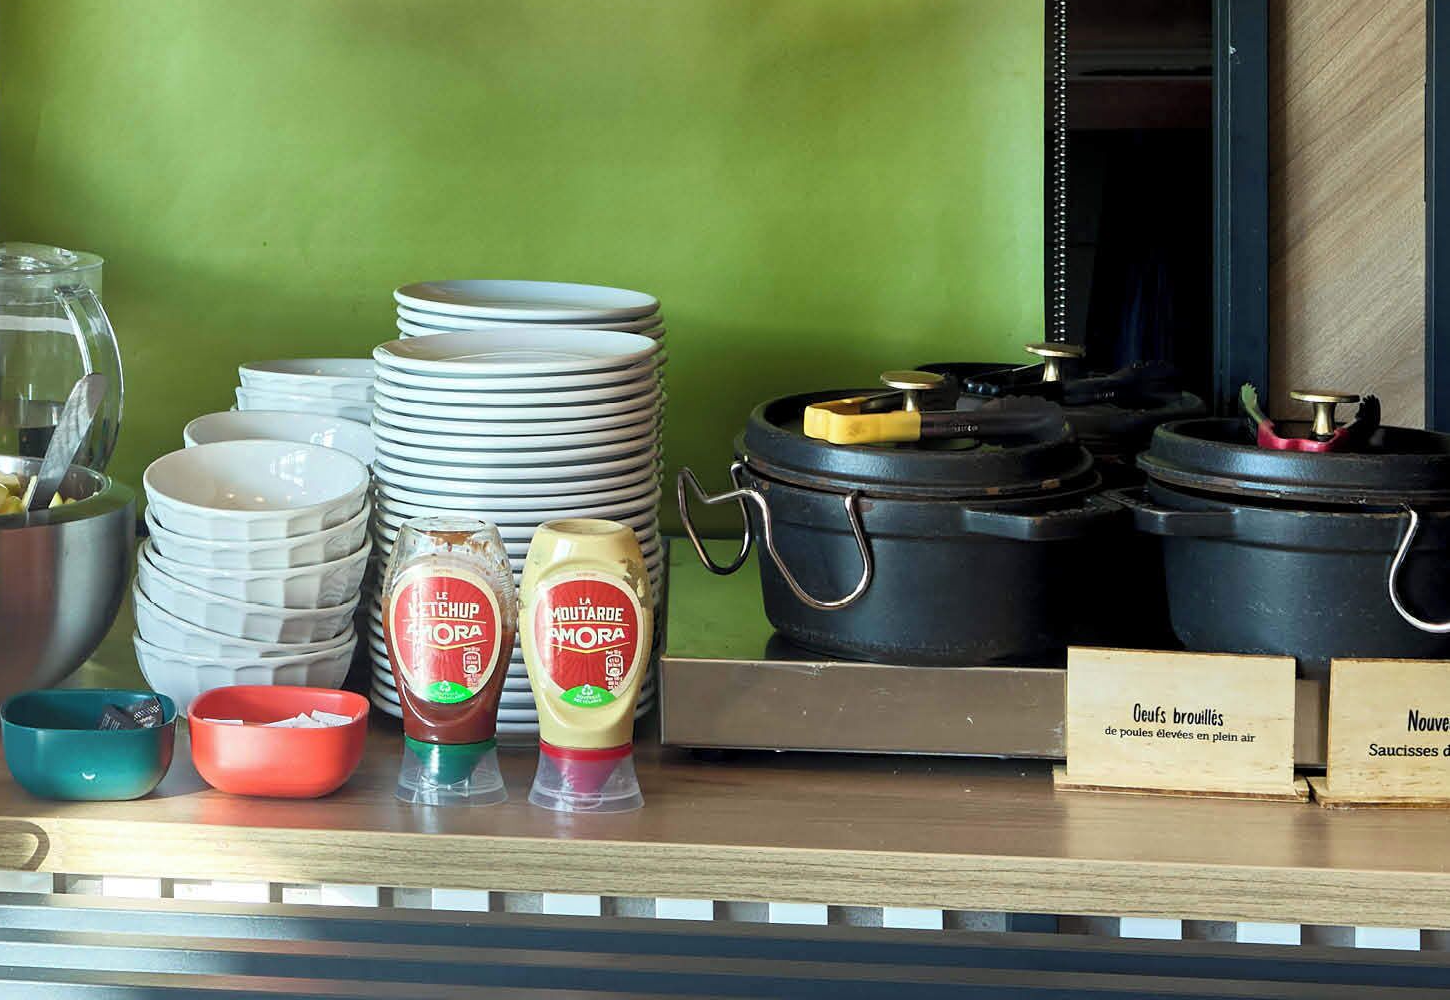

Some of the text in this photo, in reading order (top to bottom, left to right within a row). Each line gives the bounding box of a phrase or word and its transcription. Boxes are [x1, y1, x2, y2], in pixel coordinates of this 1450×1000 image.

[435, 591, 449, 600] LE
[579, 597, 592, 606] LA
[548, 605, 624, 622] MOUTARDE
[548, 626, 626, 649] AMORA
[1133, 703, 1224, 726] Oeufs brouillés
[1408, 709, 1450, 732] Nouve
[1105, 726, 1257, 743] de poules élevées en plein air
[1369, 743, 1439, 757] Saucisses
